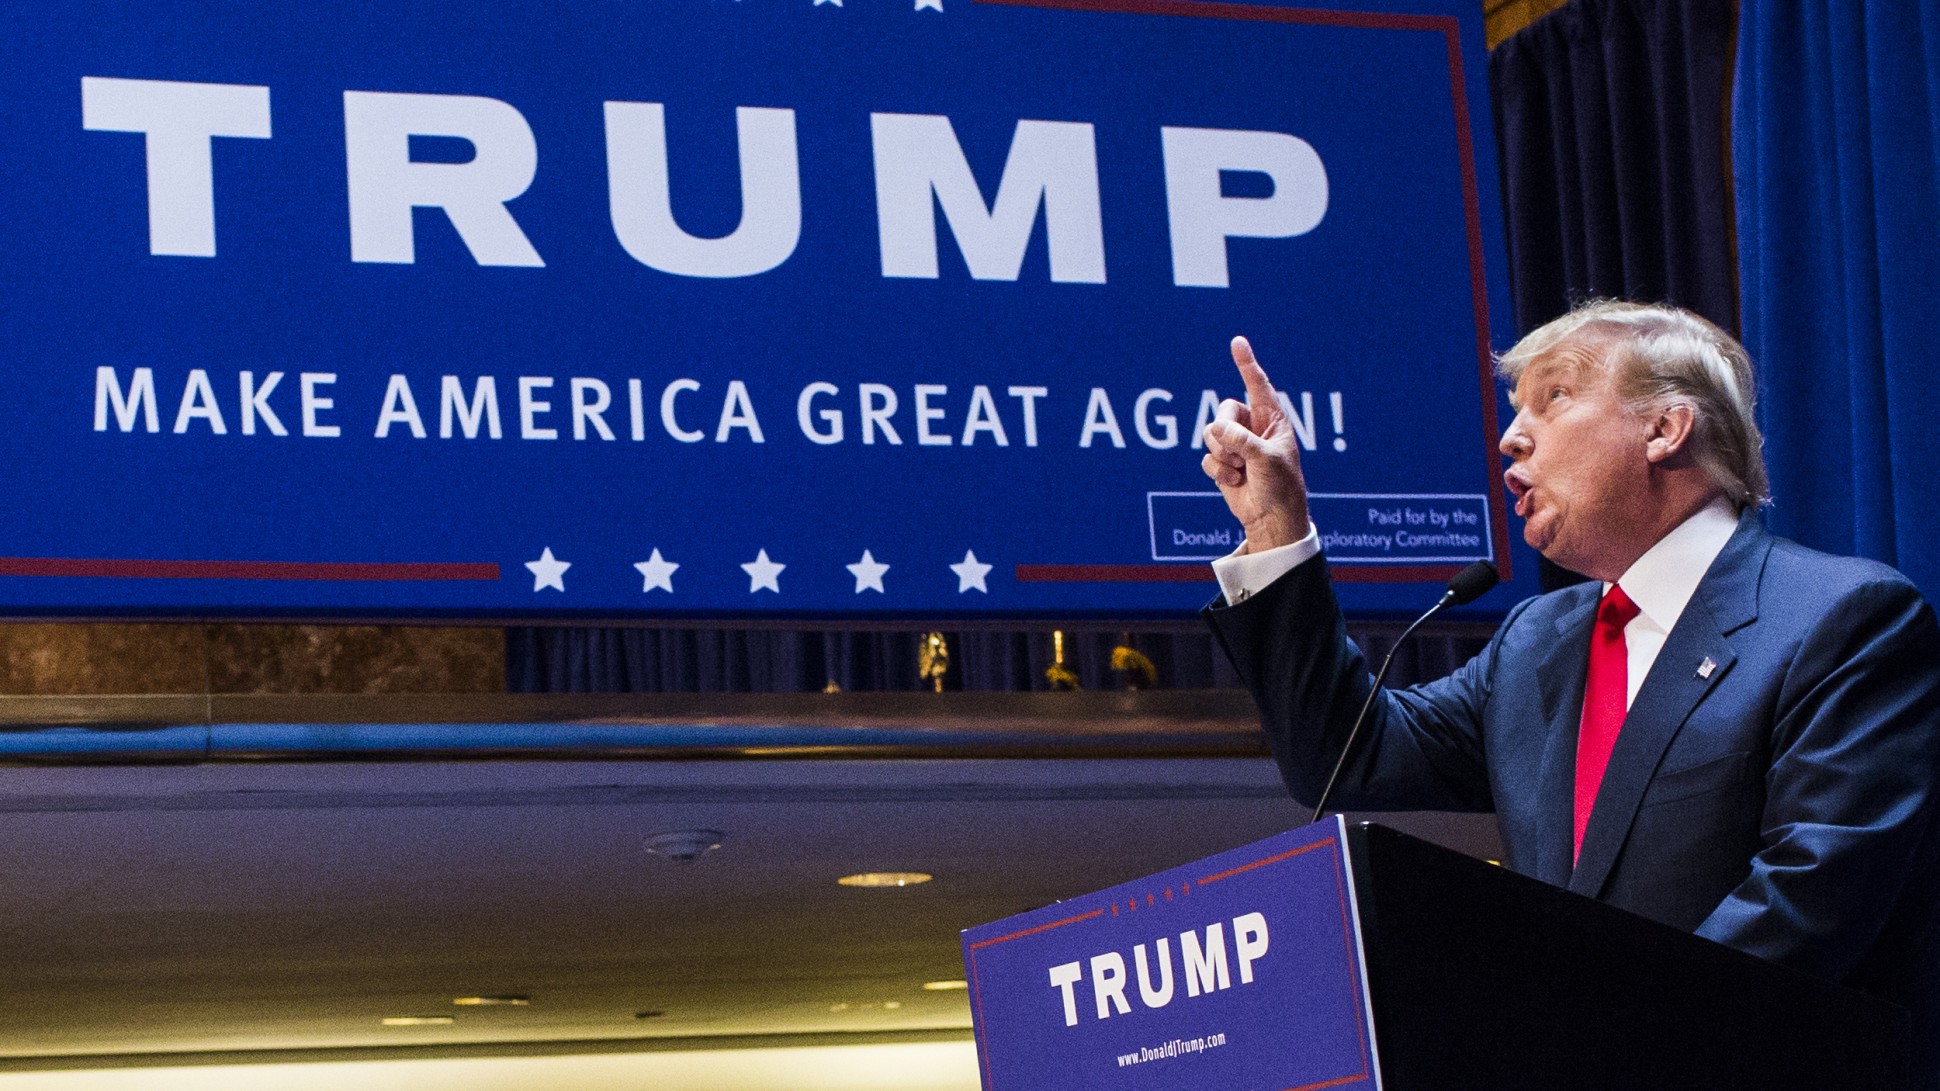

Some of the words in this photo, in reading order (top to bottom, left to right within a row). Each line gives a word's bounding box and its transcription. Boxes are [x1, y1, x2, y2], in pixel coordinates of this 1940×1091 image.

[81, 76, 1329, 288] TRUMP
[94, 366, 341, 438] MAKE
[374, 374, 765, 444] AMERICA
[797, 382, 1049, 447] GREAT
[1079, 386, 1347, 452] AGAN!
[1173, 528, 1231, 546] Donald
[1395, 530, 1480, 547] Committee
[1368, 507, 1402, 525] Paid
[1405, 507, 1426, 524] for
[1429, 508, 1449, 528] by
[1453, 508, 1478, 524] the
[1049, 911, 1270, 1027] TRUMP
[1116, 1032, 1227, 1068] www.DonaldJTrump.com
